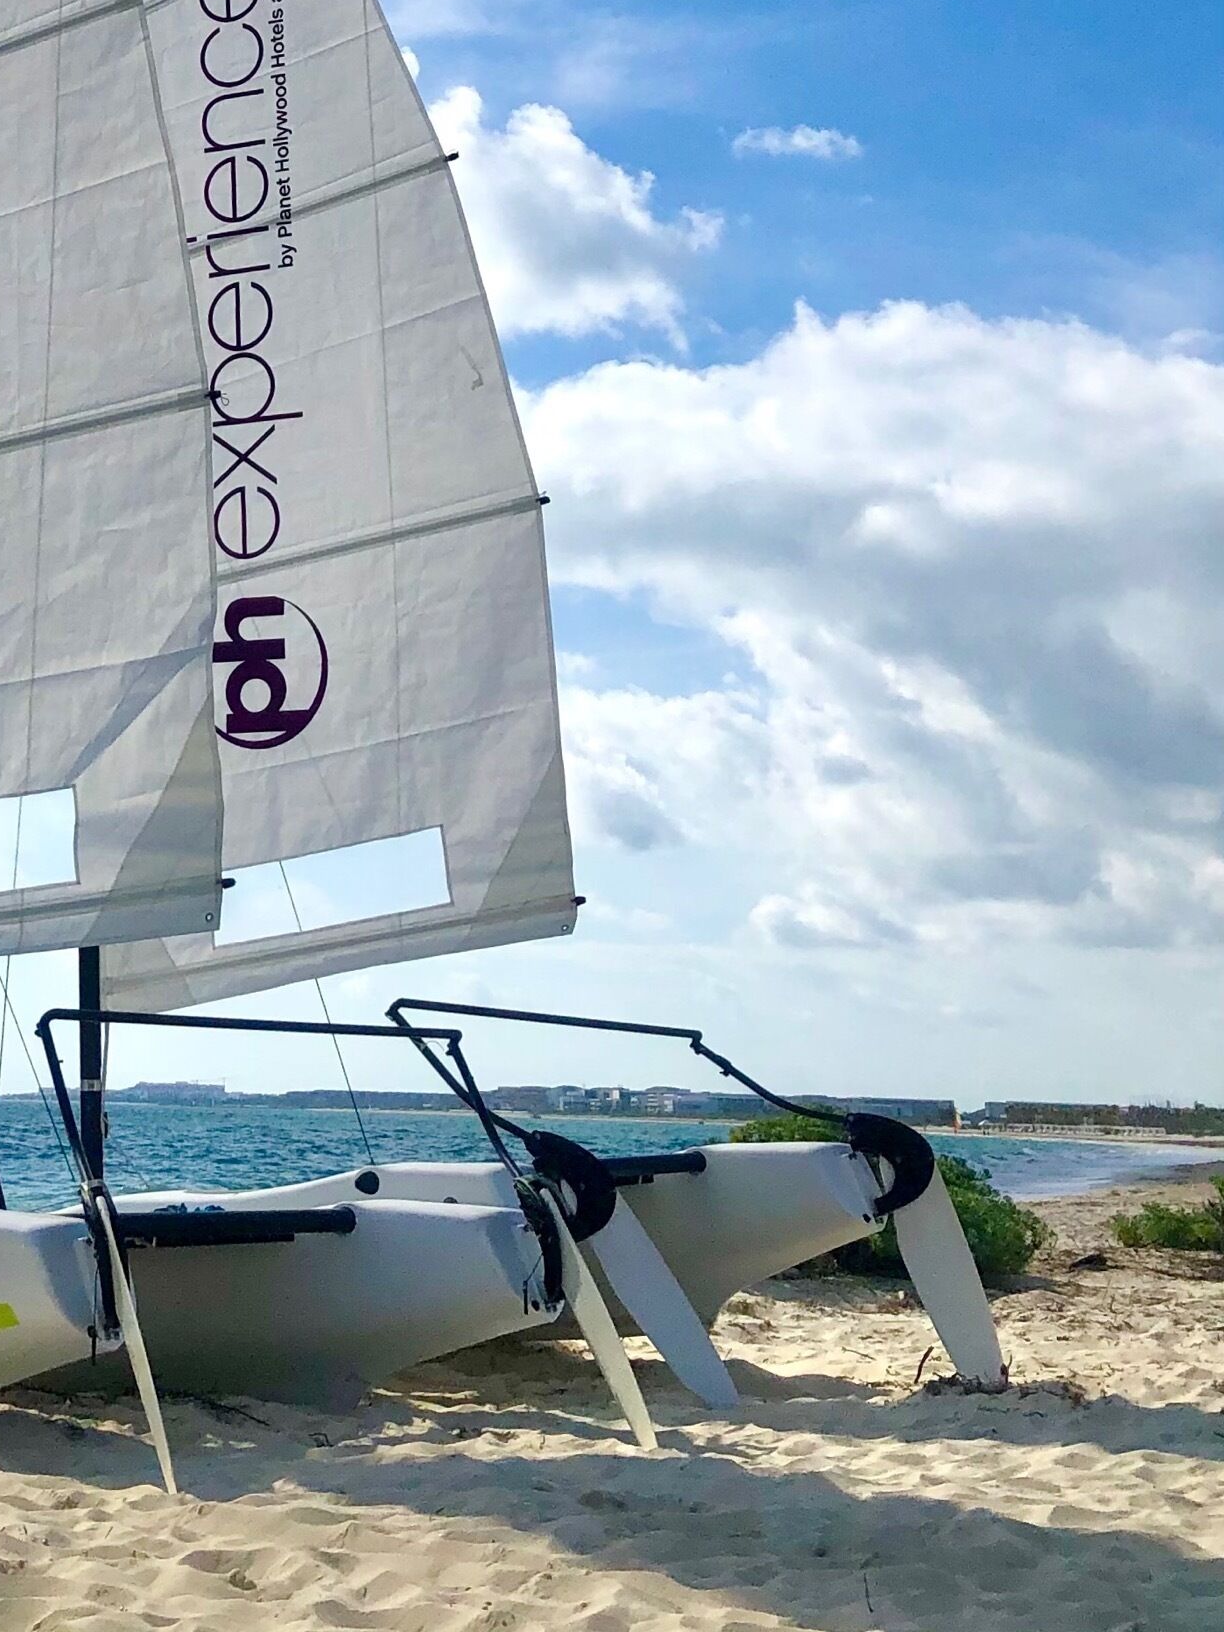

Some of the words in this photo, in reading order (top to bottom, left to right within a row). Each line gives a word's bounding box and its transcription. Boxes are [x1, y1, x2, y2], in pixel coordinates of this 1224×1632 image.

[268, 7, 285, 68] Hotels
[271, 73, 293, 172] Hollywood
[275, 176, 293, 238] Planet
[277, 244, 297, 269] by
